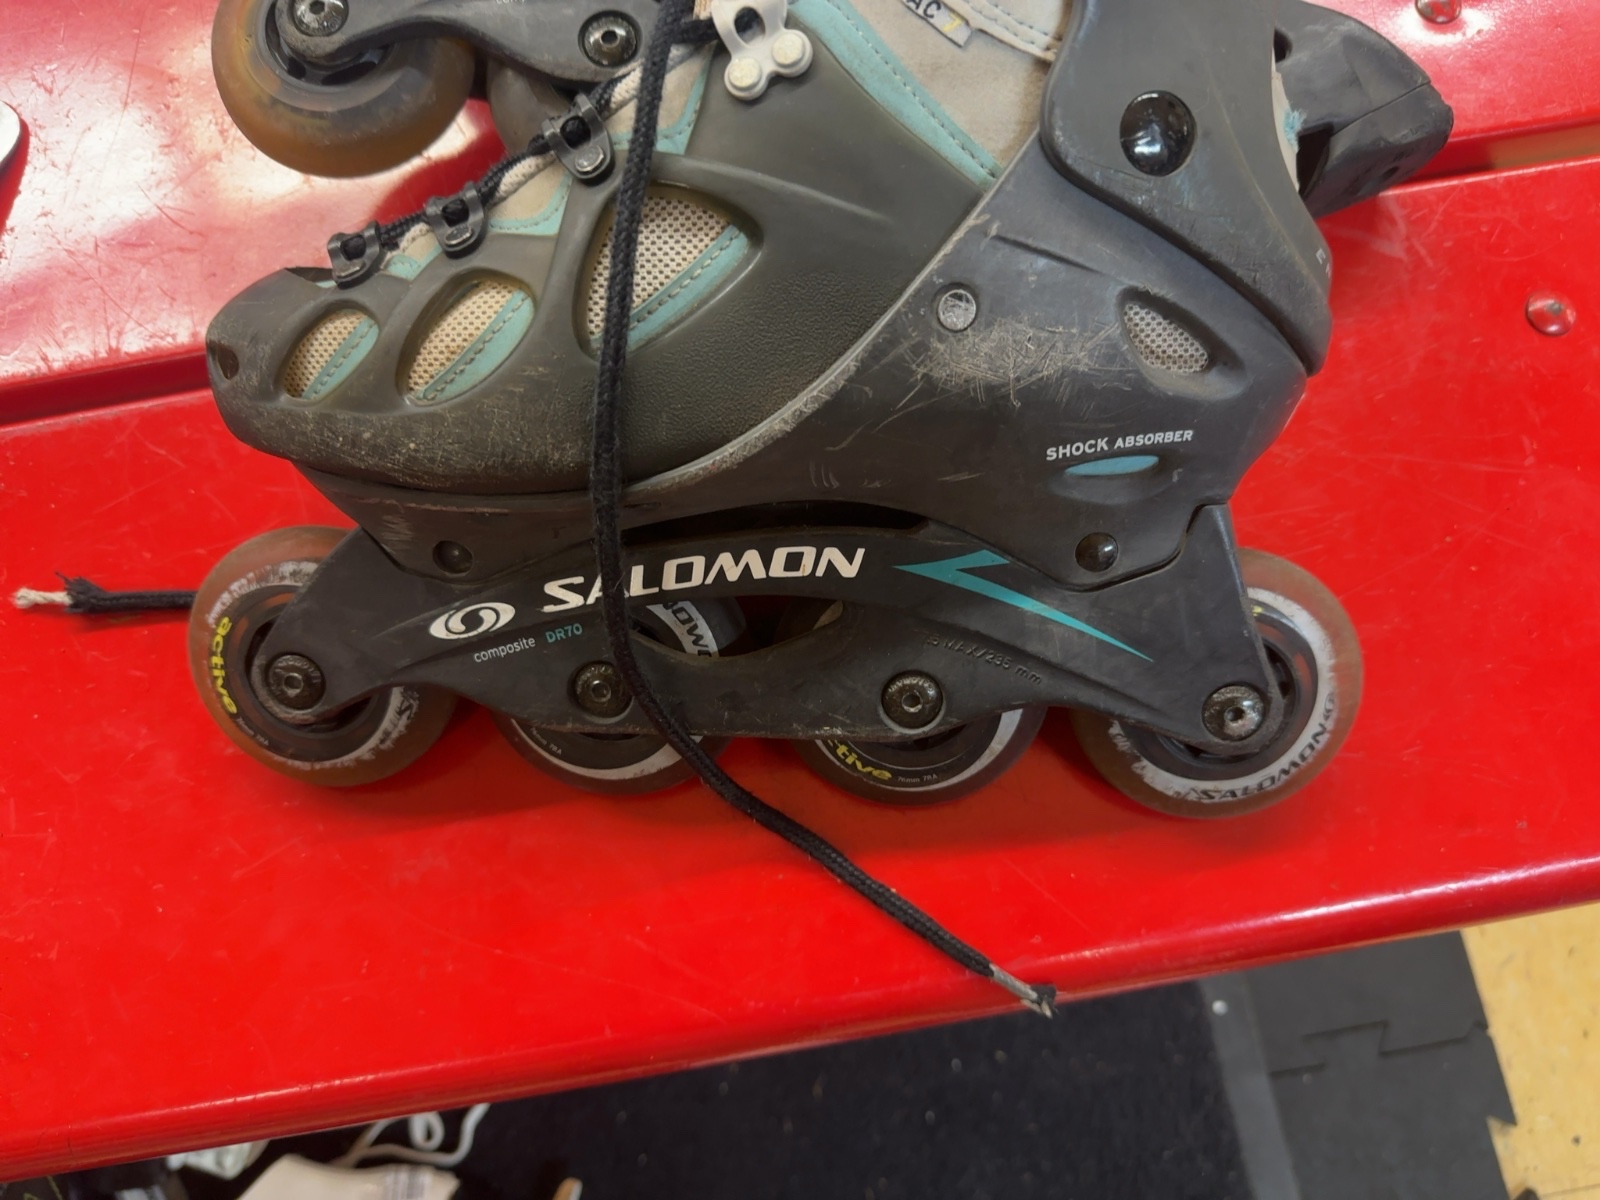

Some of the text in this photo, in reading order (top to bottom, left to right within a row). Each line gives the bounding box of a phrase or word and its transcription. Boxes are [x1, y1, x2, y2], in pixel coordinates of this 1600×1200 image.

[1046, 429, 1194, 461] SHOCK ABSORBER
[473, 623, 583, 662] composite DR70
[211, 616, 238, 714] active
[1015, 665, 1042, 684] mm
[1200, 722, 1328, 800] SALOMON
